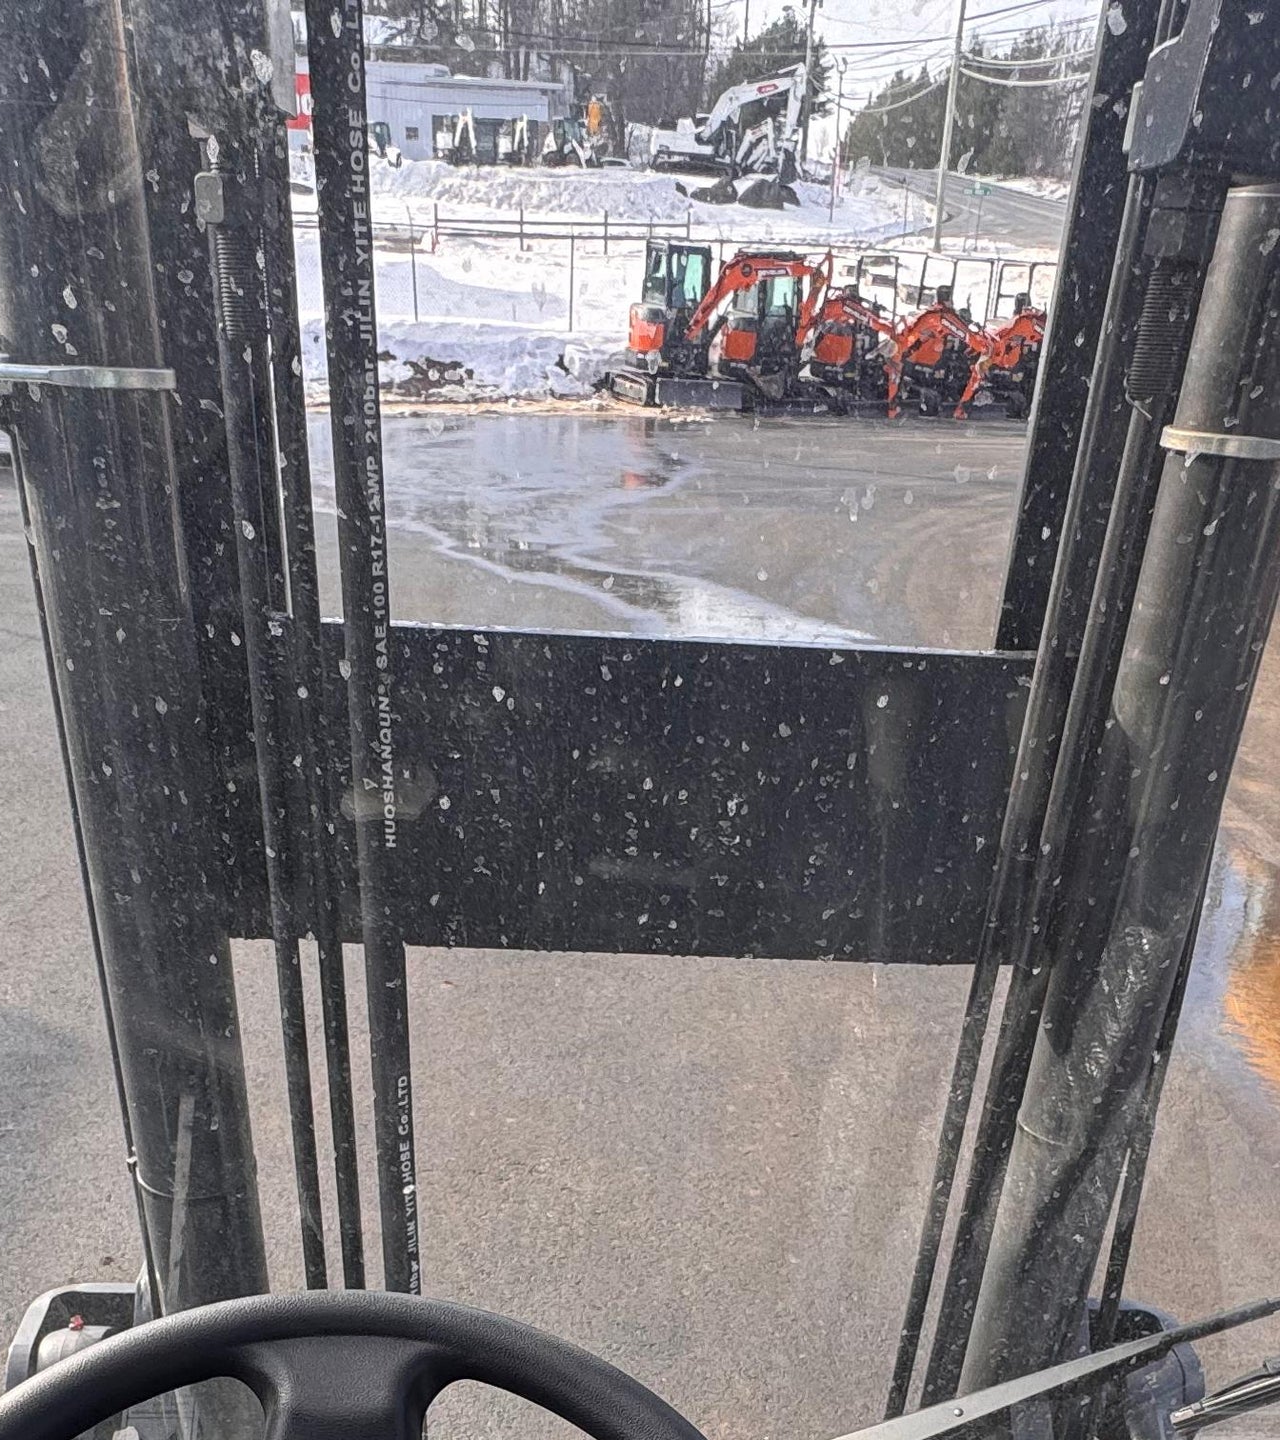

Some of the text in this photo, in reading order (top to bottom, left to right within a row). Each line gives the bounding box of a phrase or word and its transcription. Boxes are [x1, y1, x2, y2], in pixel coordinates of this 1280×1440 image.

[348, 112, 365, 194] HOSE
[353, 203, 372, 267] YITE
[357, 279, 376, 347] JILIN
[372, 583, 387, 621] 100
[373, 623, 389, 670] SAE
[402, 1185, 416, 1217] YIT
